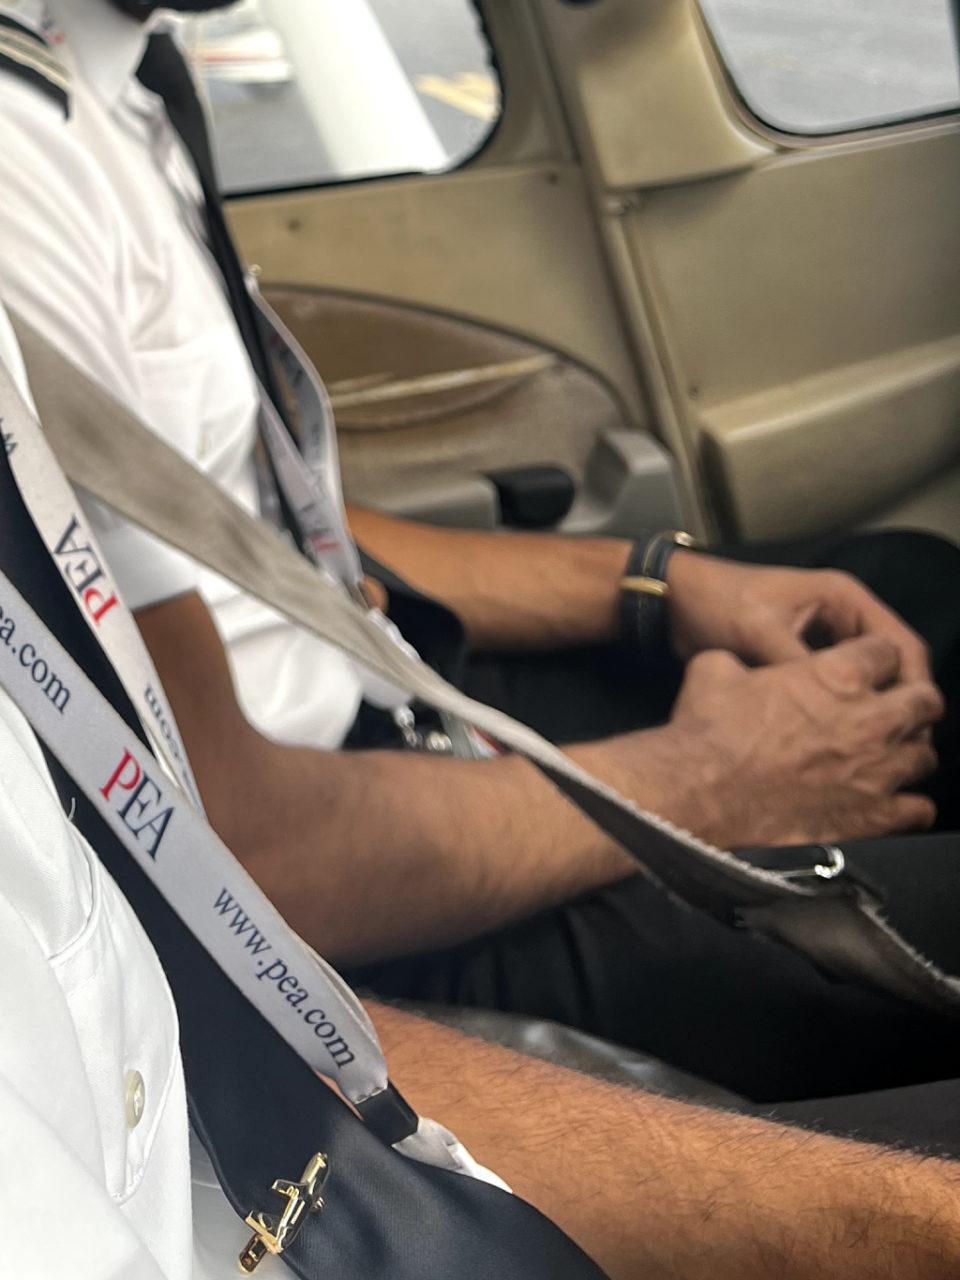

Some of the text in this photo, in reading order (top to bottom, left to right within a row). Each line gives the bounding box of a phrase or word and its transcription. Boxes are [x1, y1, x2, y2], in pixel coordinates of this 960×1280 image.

[54, 513, 120, 626] PEA
[99, 747, 177, 862] PEA
[212, 886, 356, 1070] www.pea.com
